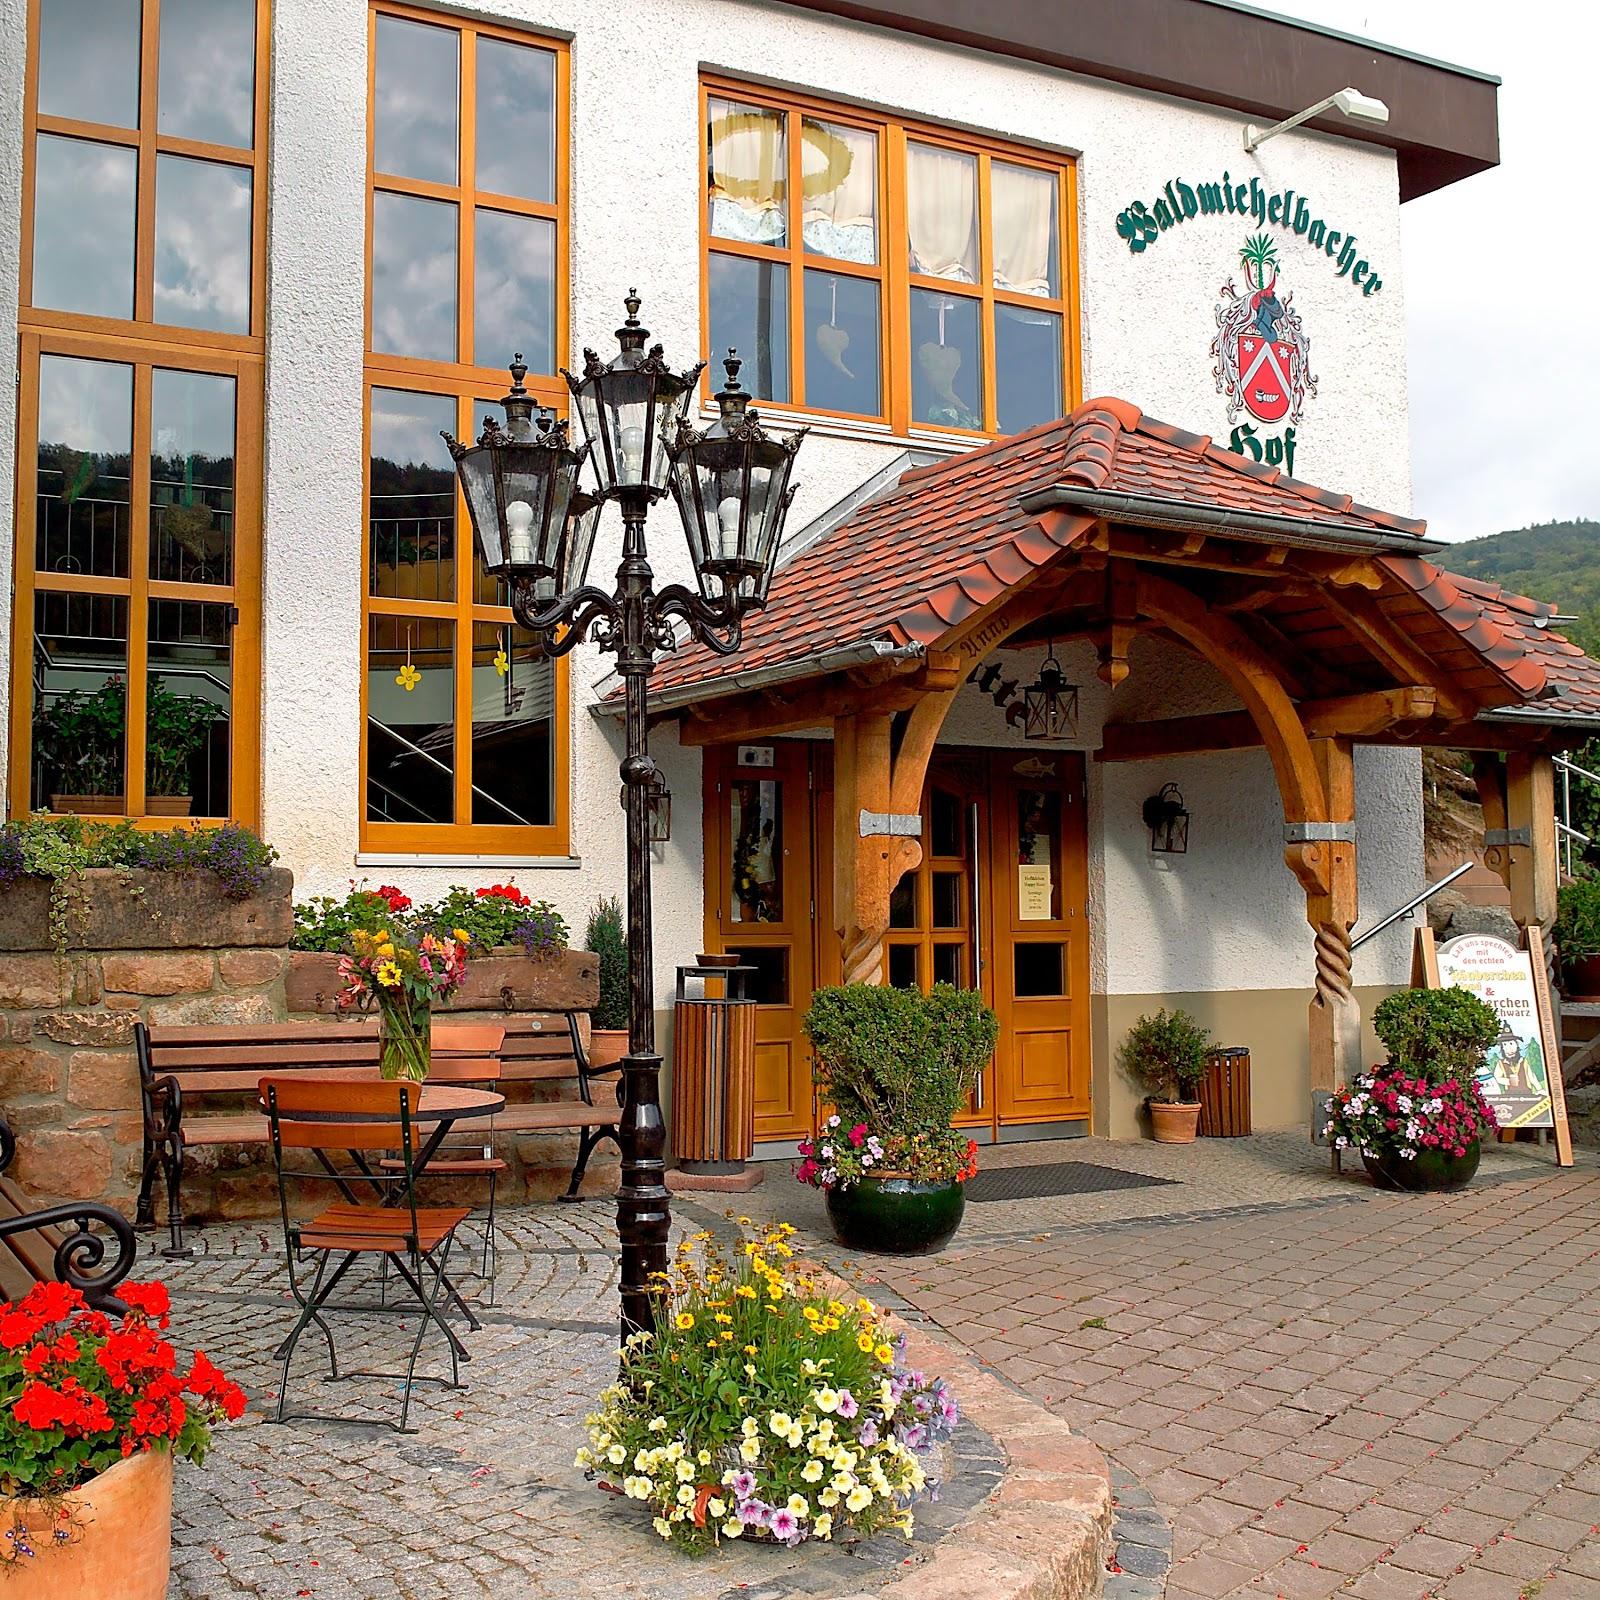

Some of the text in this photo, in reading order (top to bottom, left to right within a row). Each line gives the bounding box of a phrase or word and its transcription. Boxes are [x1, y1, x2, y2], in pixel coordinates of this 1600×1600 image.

[1116, 170, 1382, 297] Waldmichelbacher
[1228, 423, 1297, 478] Hof
[1480, 940, 1513, 959] spechten
[1485, 987, 1495, 996] &
[1485, 997, 1529, 1008] erchen
[1495, 1008, 1531, 1017] chwarz
